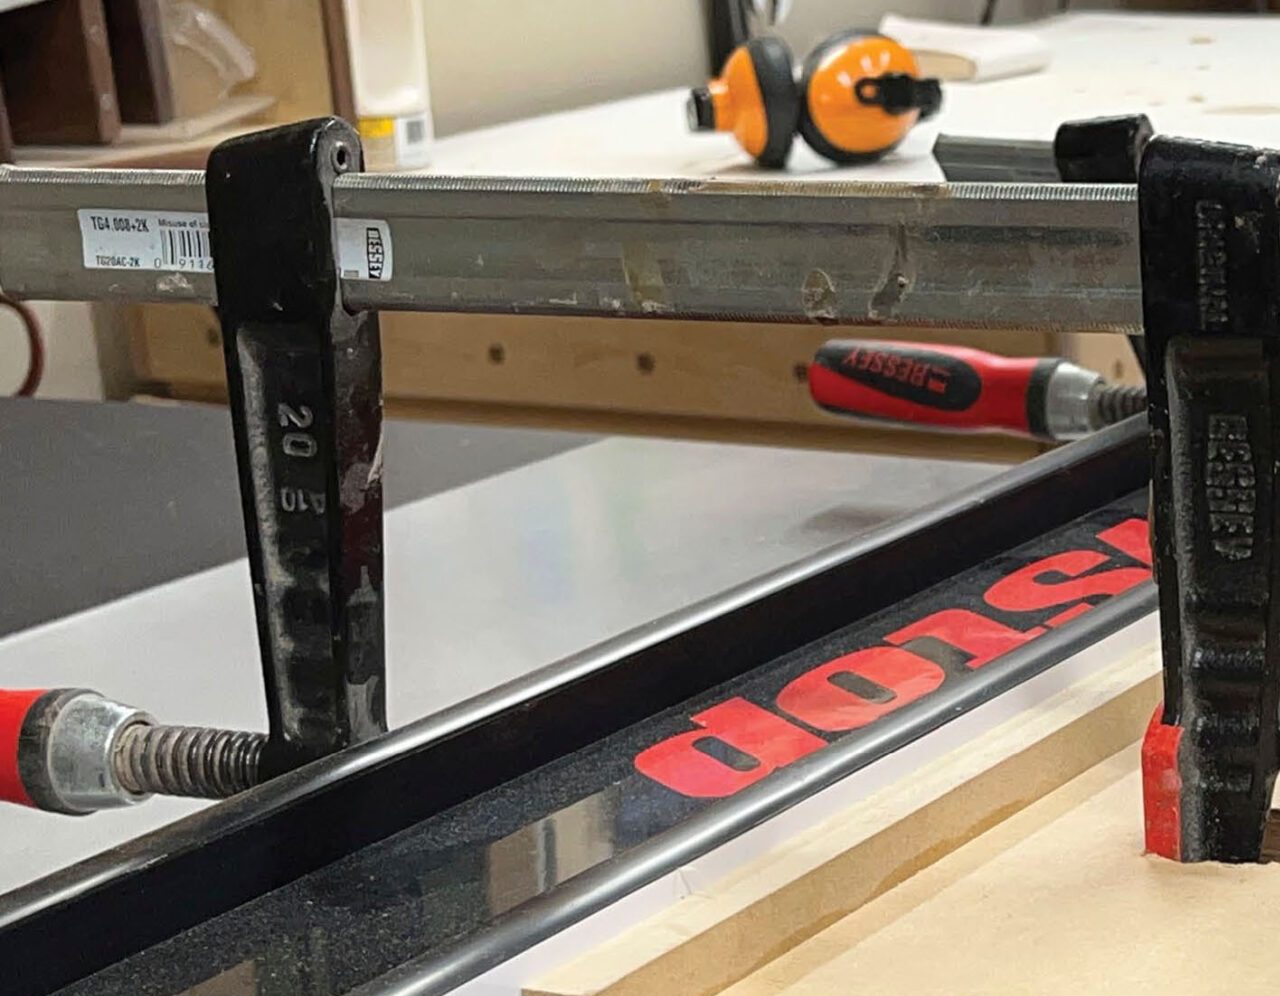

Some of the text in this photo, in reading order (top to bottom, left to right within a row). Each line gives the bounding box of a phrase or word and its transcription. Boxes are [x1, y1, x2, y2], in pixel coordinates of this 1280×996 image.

[158, 219, 187, 227] Misuse
[189, 219, 198, 227] of
[367, 228, 384, 279] BESSEY
[843, 348, 931, 388] BESSEY
[278, 403, 318, 458] 20
